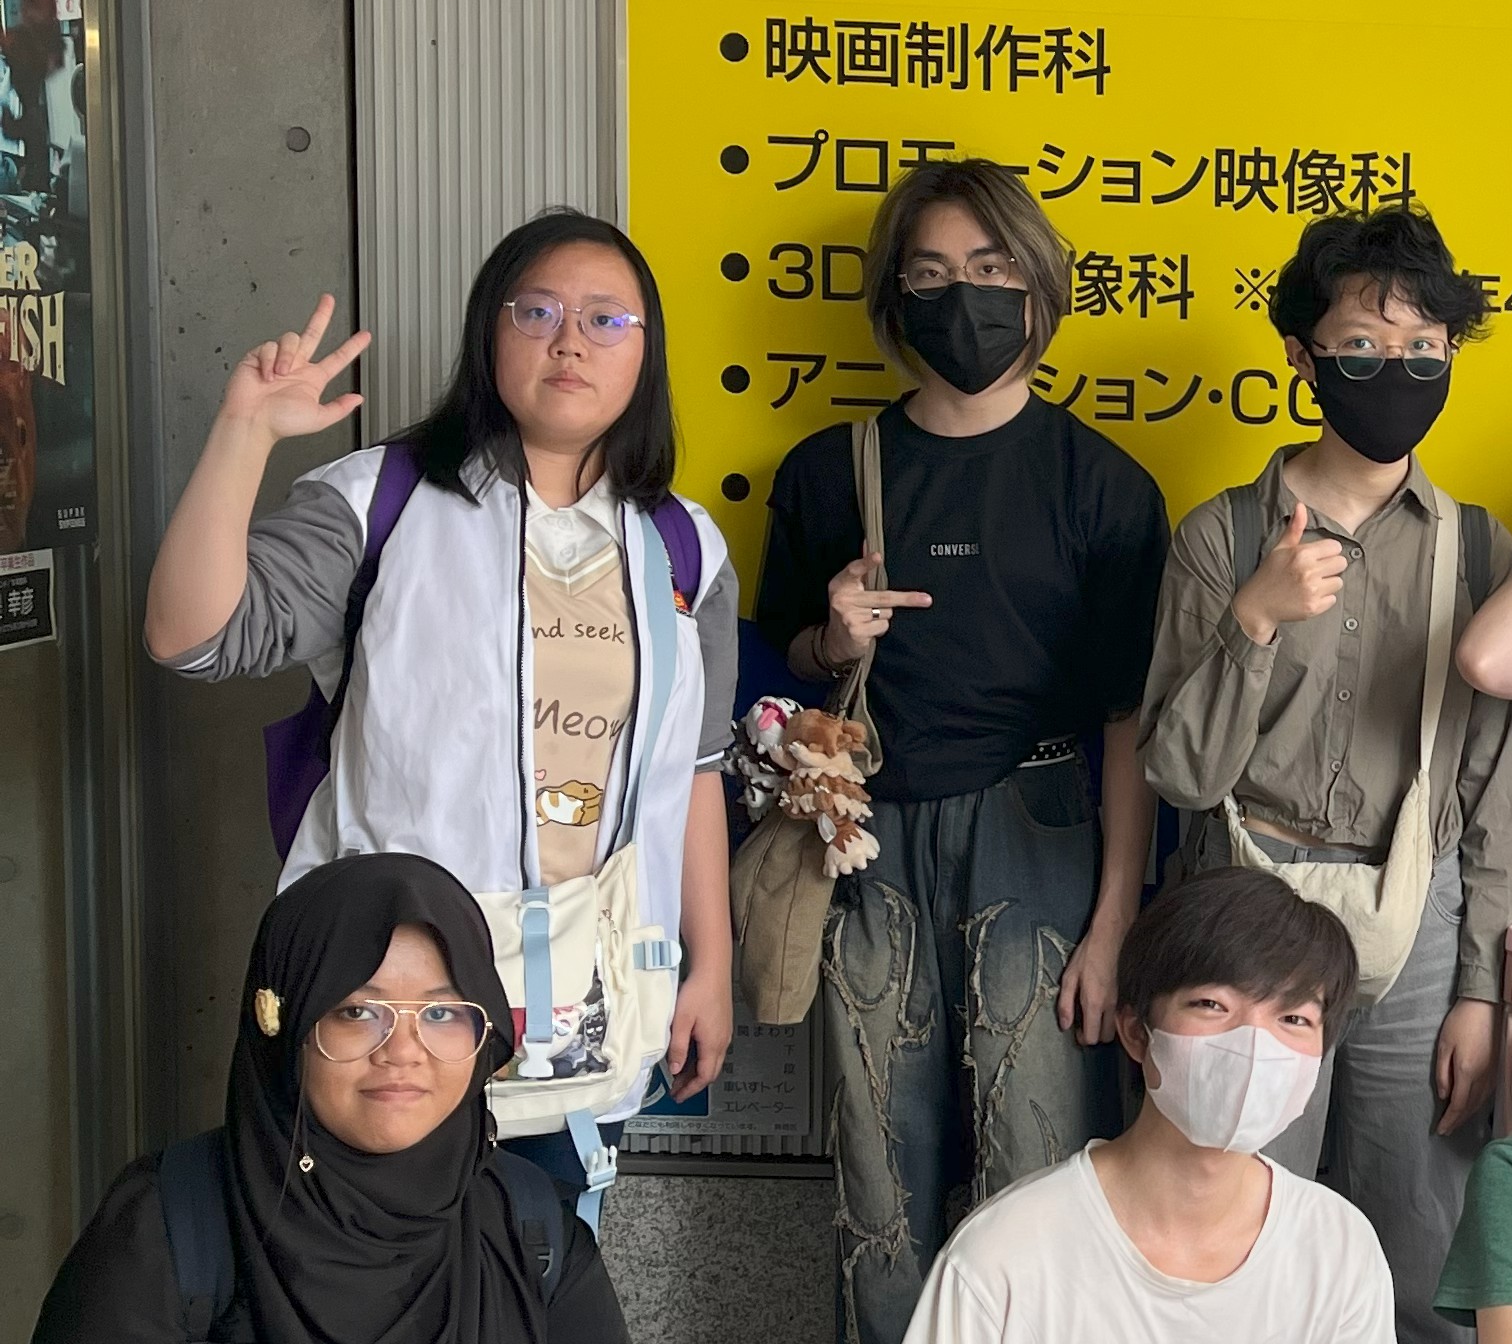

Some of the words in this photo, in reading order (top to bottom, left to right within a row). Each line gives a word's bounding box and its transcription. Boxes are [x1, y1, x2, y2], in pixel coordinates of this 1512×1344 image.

[764, 16, 1112, 97] 映画制作科
[767, 242, 1195, 320] 3D像科
[574, 622, 625, 645] seek
[723, 1081, 795, 1095] 車いすトイレ
[723, 1101, 794, 1114] エレベーター
